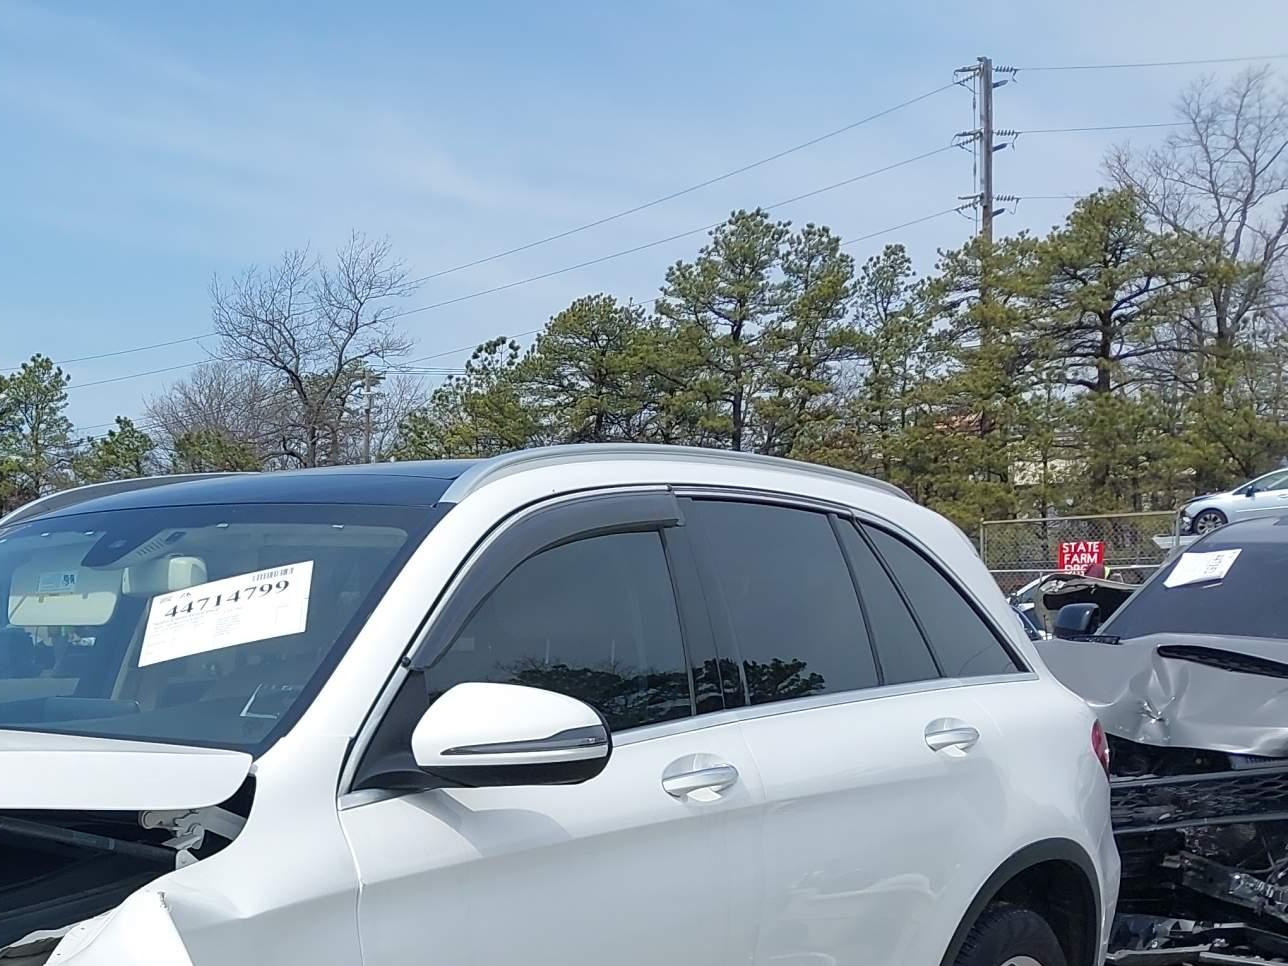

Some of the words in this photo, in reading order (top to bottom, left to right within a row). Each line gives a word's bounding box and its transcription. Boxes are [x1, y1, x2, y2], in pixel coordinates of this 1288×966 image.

[1062, 541, 1099, 553] STATE
[1064, 553, 1098, 564] FARM
[164, 580, 289, 617] 44714799
